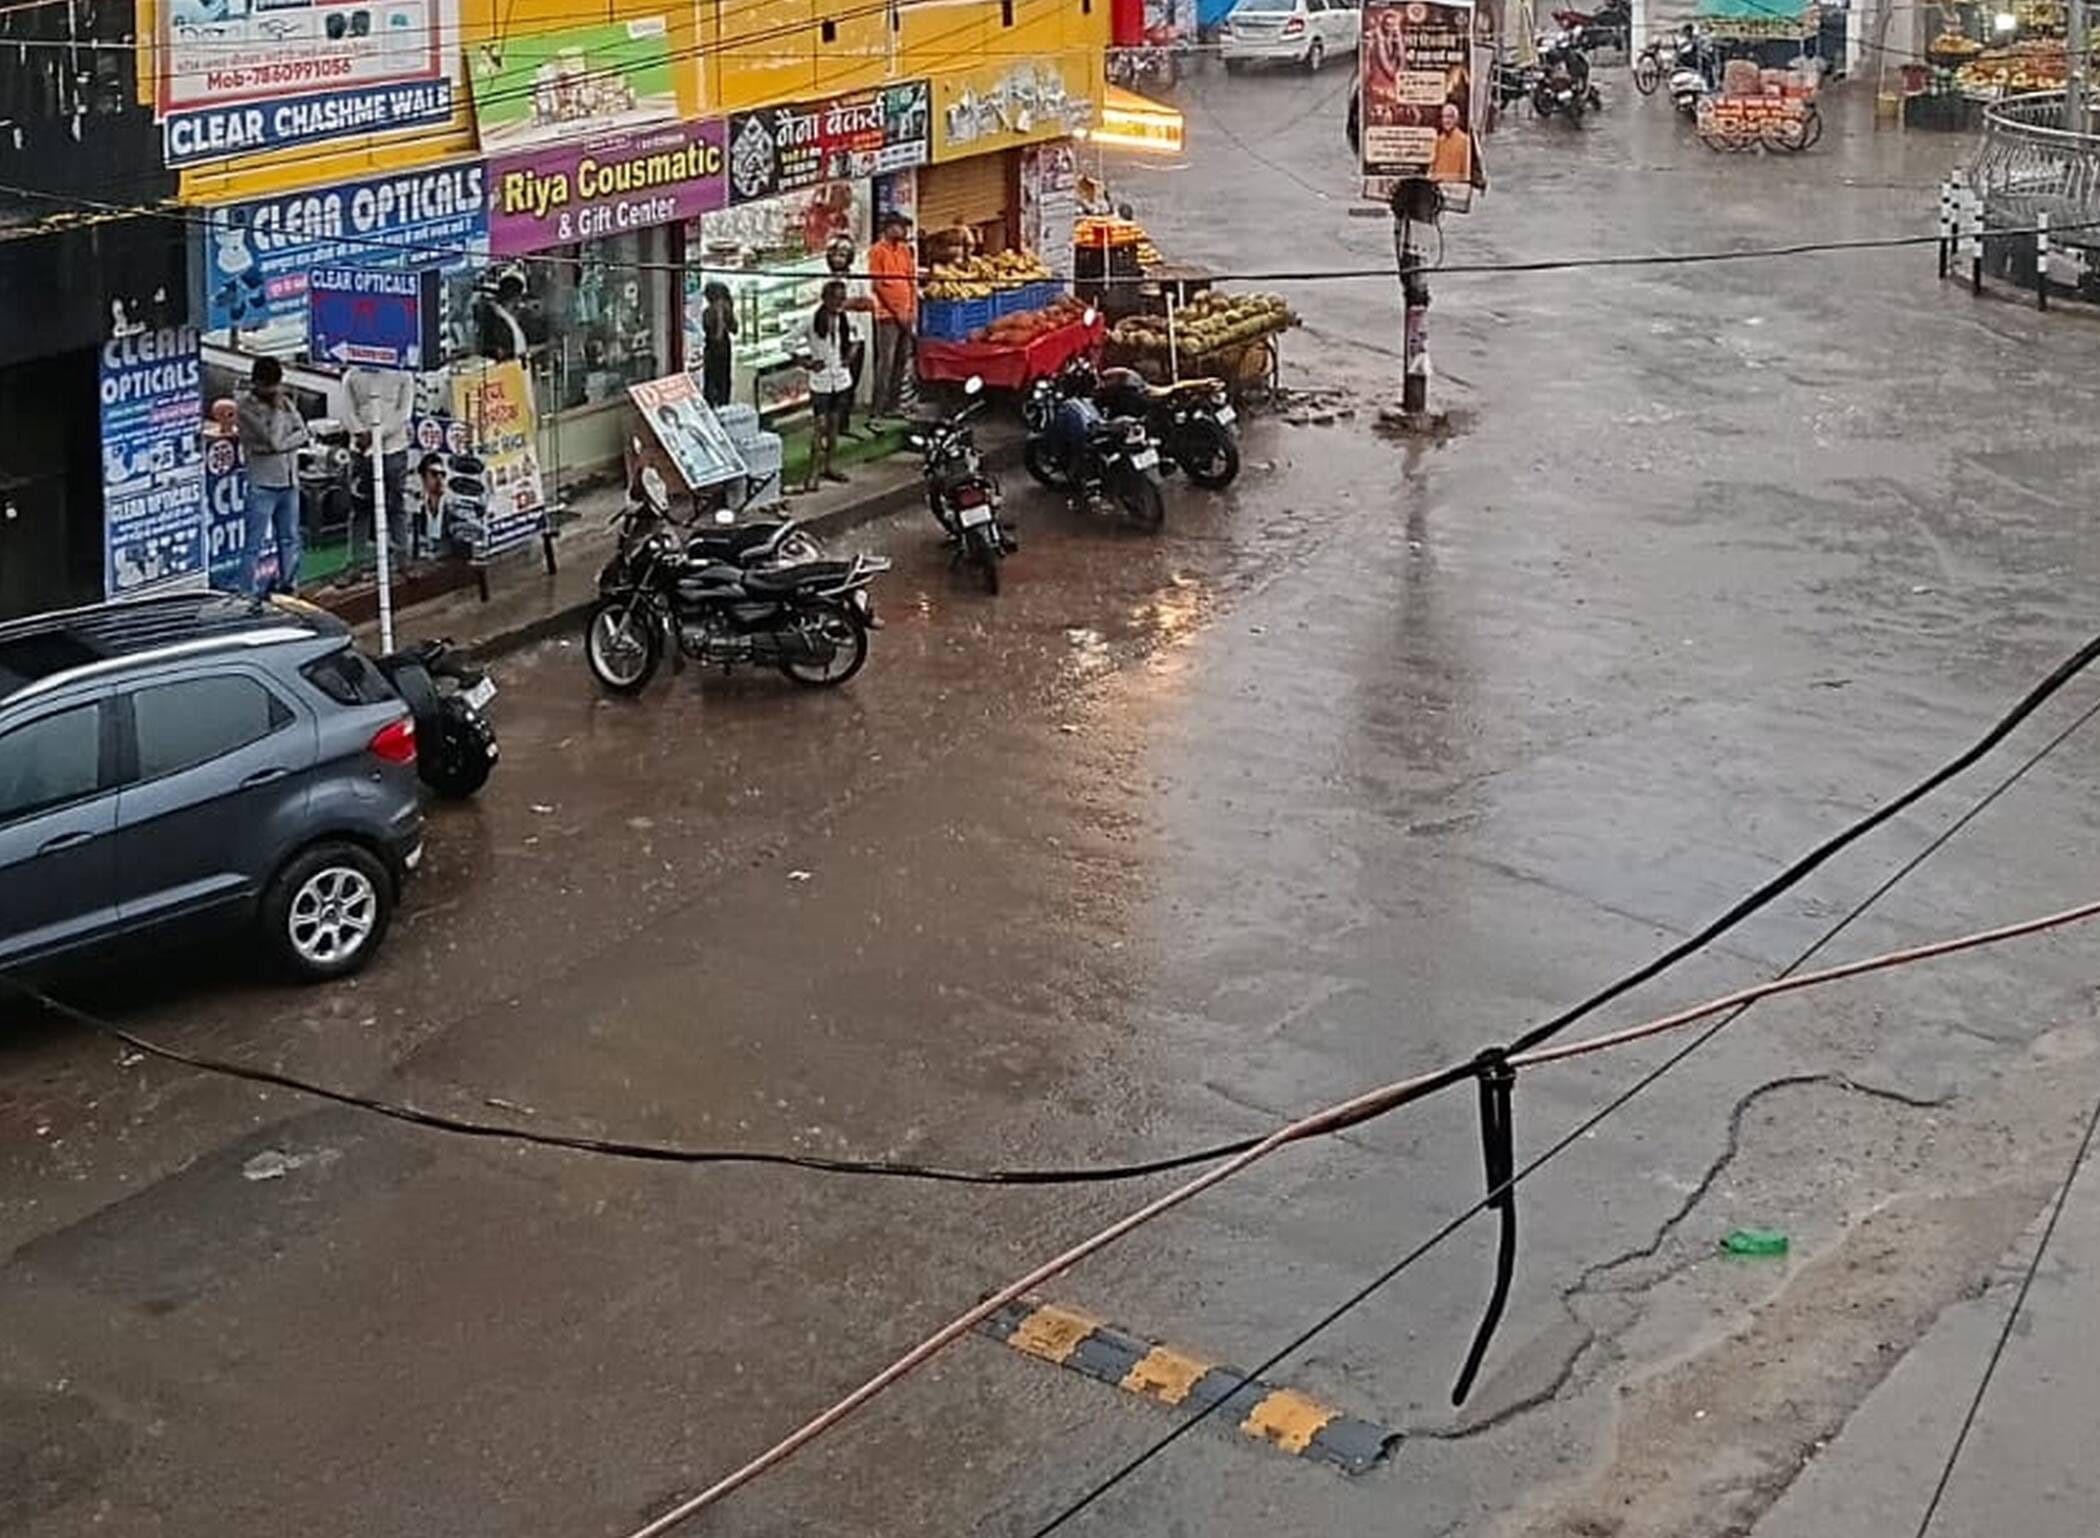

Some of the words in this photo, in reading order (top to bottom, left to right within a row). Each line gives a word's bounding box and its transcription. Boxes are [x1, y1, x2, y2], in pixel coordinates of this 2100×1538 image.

[171, 110, 266, 154] CLEAR
[274, 95, 387, 137] CHASHME
[504, 171, 569, 217] Riya
[578, 140, 722, 199] Cousmatic
[253, 193, 342, 251] CLEAR
[352, 168, 482, 232] OPTICALS
[558, 213, 573, 240] &
[578, 205, 612, 235] Gift
[616, 197, 677, 227] Center
[311, 269, 352, 291] CLEAR
[354, 271, 418, 296] OPTICALS
[103, 325, 198, 369] CLEAR
[101, 359, 199, 404] OPTICALS
